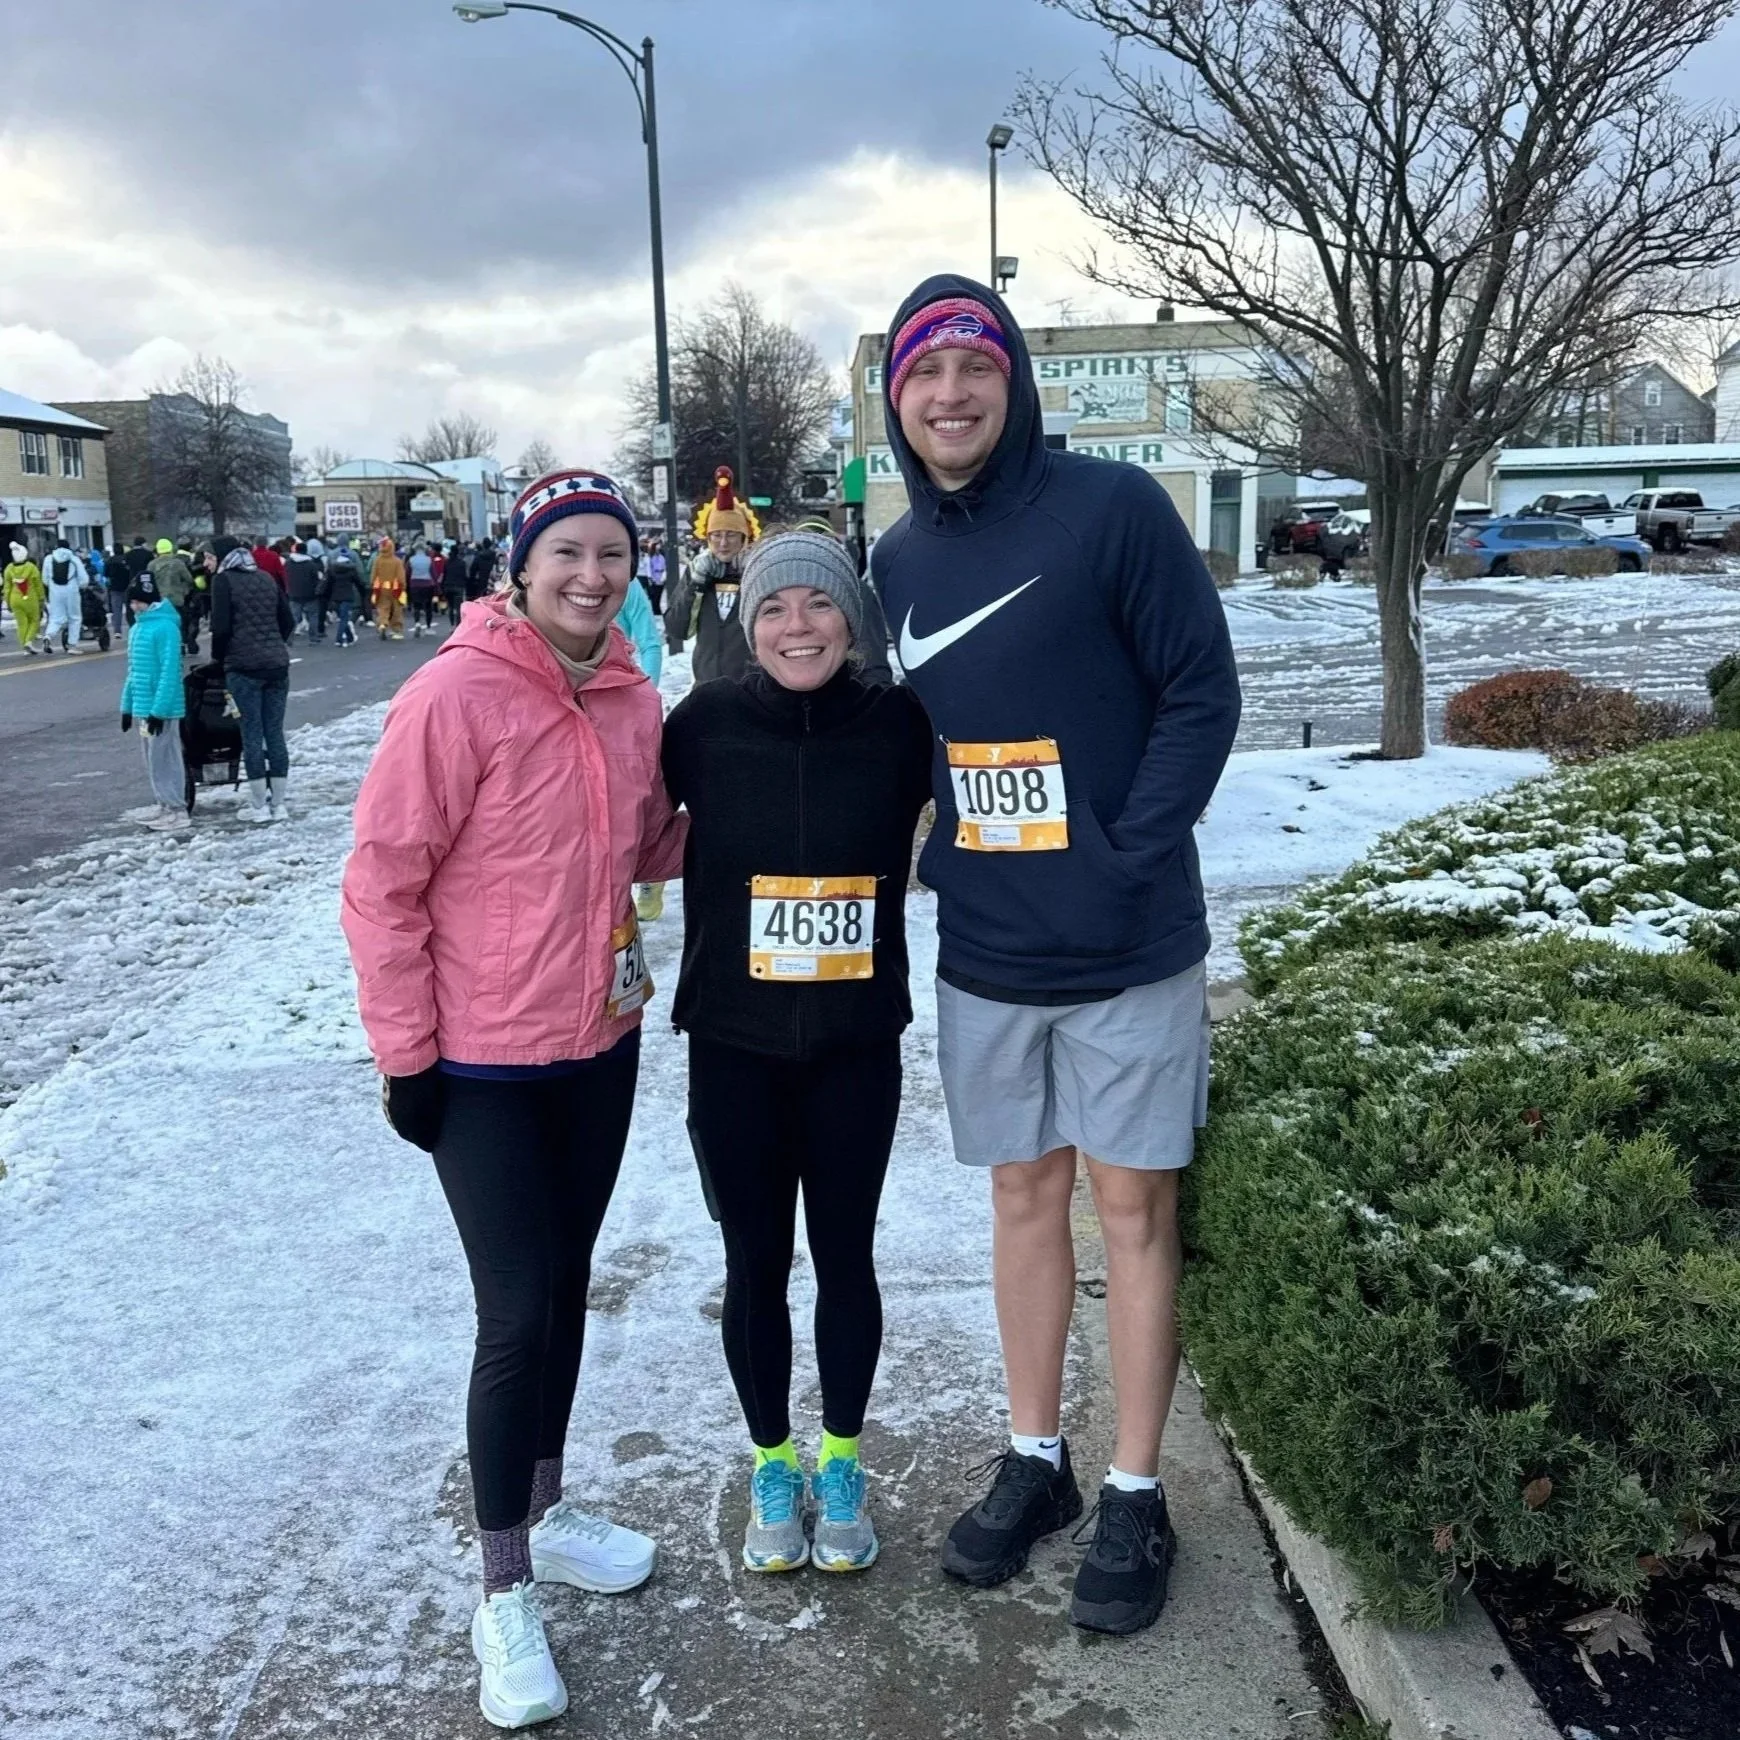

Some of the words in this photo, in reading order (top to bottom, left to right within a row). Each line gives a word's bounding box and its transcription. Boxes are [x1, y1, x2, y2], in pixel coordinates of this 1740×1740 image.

[1040, 355, 1188, 379] SPIRITS
[328, 505, 358, 516] USED
[329, 518, 359, 529] CARS
[960, 768, 1049, 816] 1098
[763, 901, 862, 946] 4638
